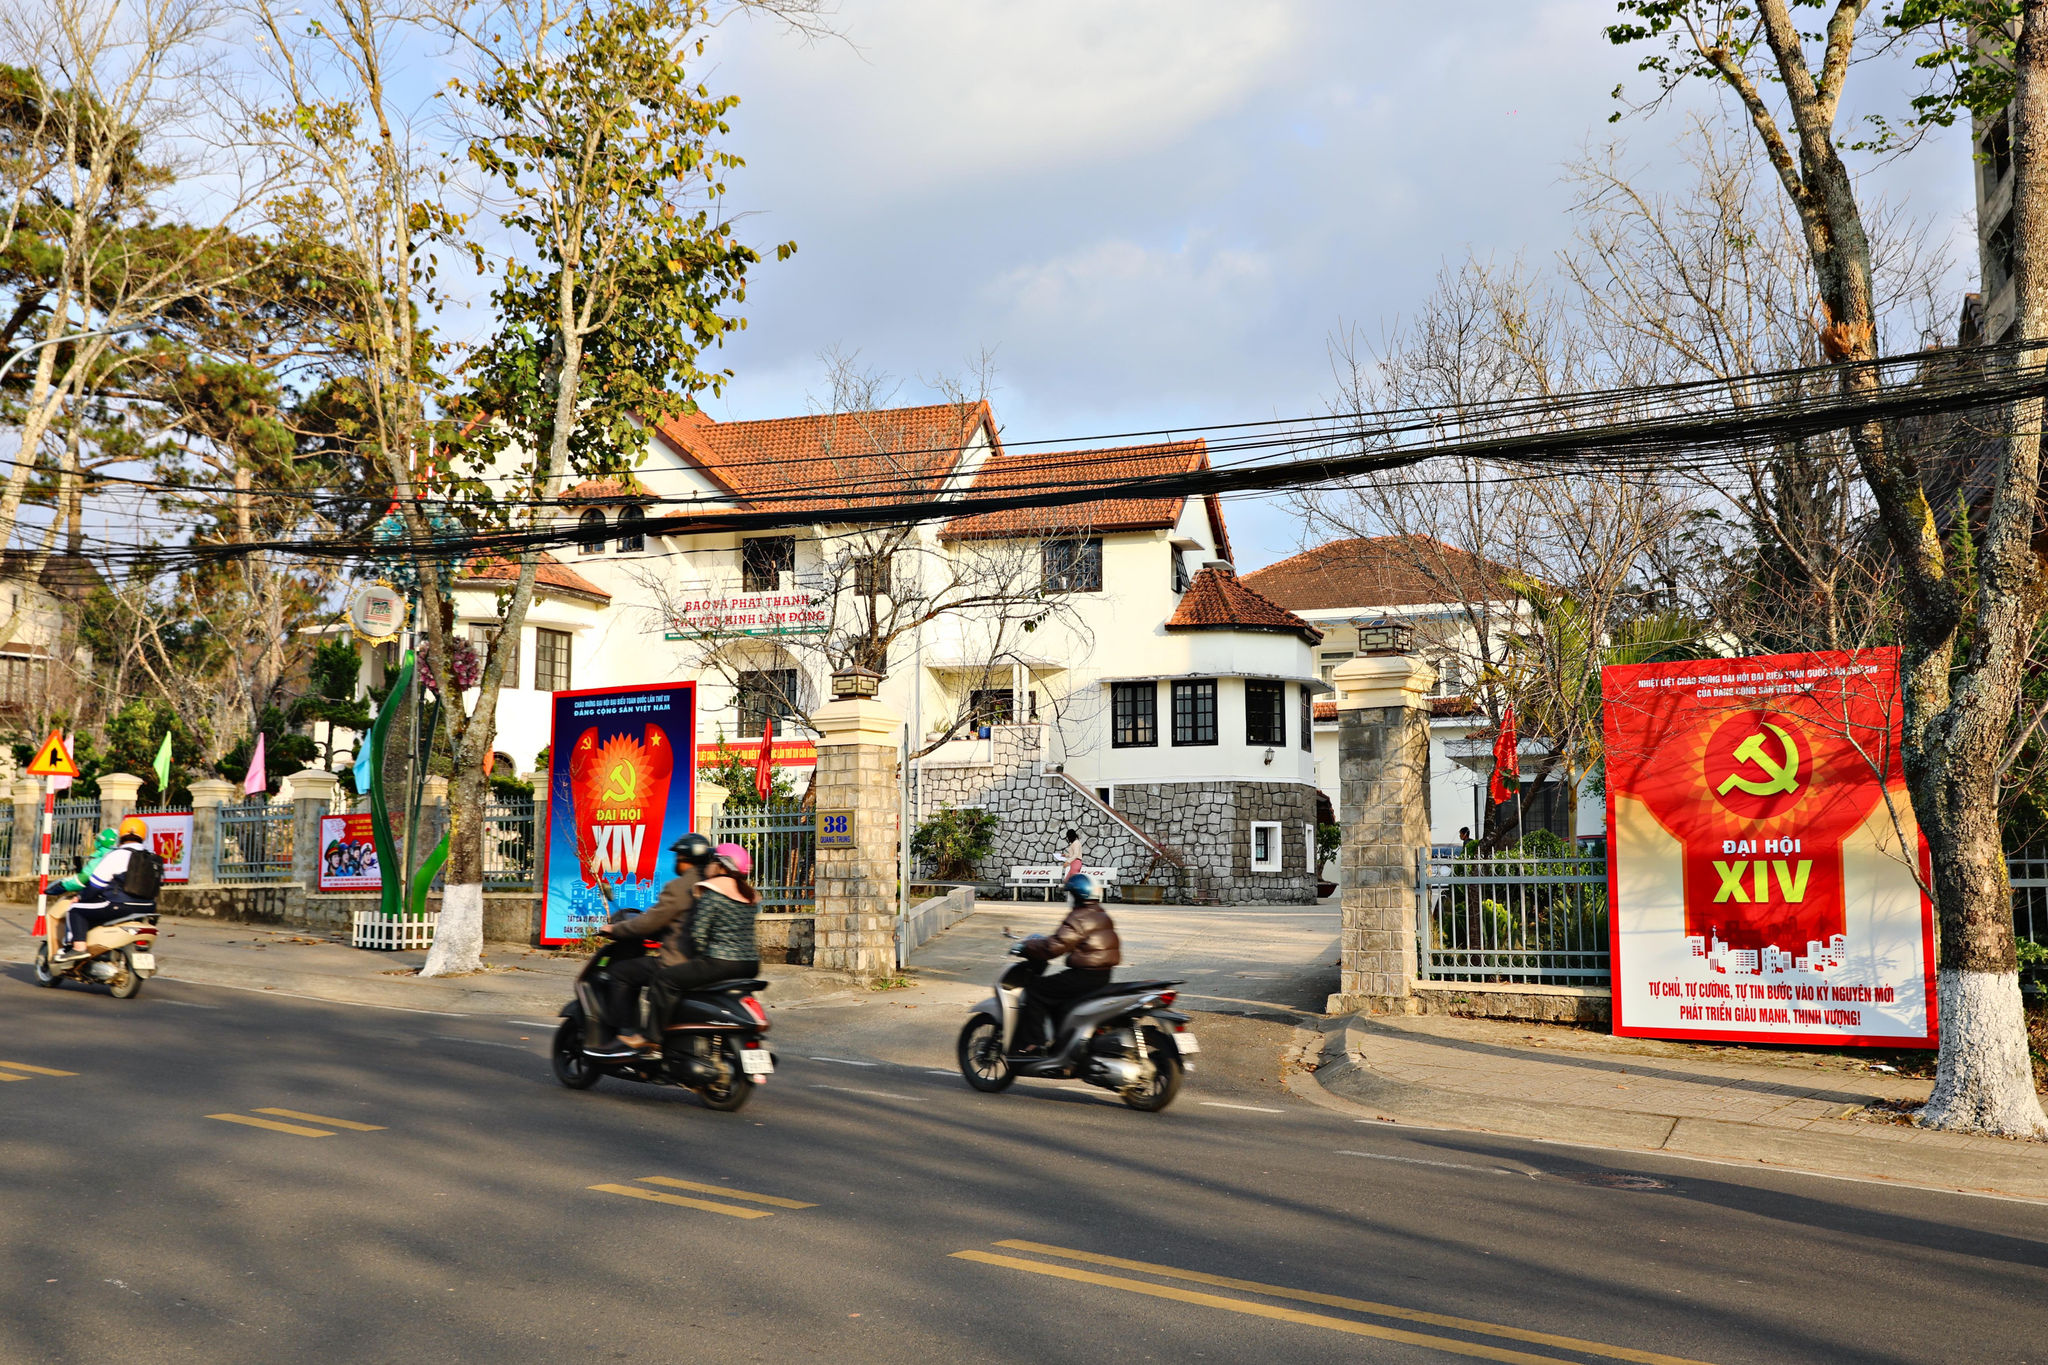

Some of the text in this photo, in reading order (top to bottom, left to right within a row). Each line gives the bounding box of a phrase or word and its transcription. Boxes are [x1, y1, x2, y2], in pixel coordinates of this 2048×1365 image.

[766, 595, 809, 607] THANH
[1638, 678, 1659, 688] NHIỆT
[1660, 677, 1675, 688] LIỆT
[1677, 675, 1696, 686] CHÀO
[1722, 674, 1735, 684] ĐẠI
[1737, 672, 1749, 683] HỘI
[1751, 672, 1764, 682] ĐẠI
[1807, 667, 1828, 677] QUỐC
[1696, 686, 1712, 698] CỦA
[1713, 685, 1734, 697] ĐẢNG
[1758, 683, 1774, 695] SẢN
[1775, 683, 1791, 694] VIỆT
[574, 708, 594, 717] ĐẢNG
[596, 707, 617, 716] CỘNG
[618, 705, 633, 714] SẢN
[635, 704, 651, 713] VIỆT
[596, 807, 641, 824] ĐẠI HỘI
[824, 815, 848, 834] 38
[591, 824, 646, 874] XIV
[821, 835, 850, 844] QUANG TRUNG
[1722, 836, 1801, 857] ĐẠI HỘI
[1712, 859, 1813, 903] XIV
[1649, 976, 1894, 1003] TỰ CHỦ, TỰ CƯỜNG, TỰ TIN BƯỚC VÀO KỶ NGUYÊN MỚI
[1680, 1001, 1861, 1028] PHÁT TRIỂN GIÀU MẠNH, THỊNH VƯỢNG!
